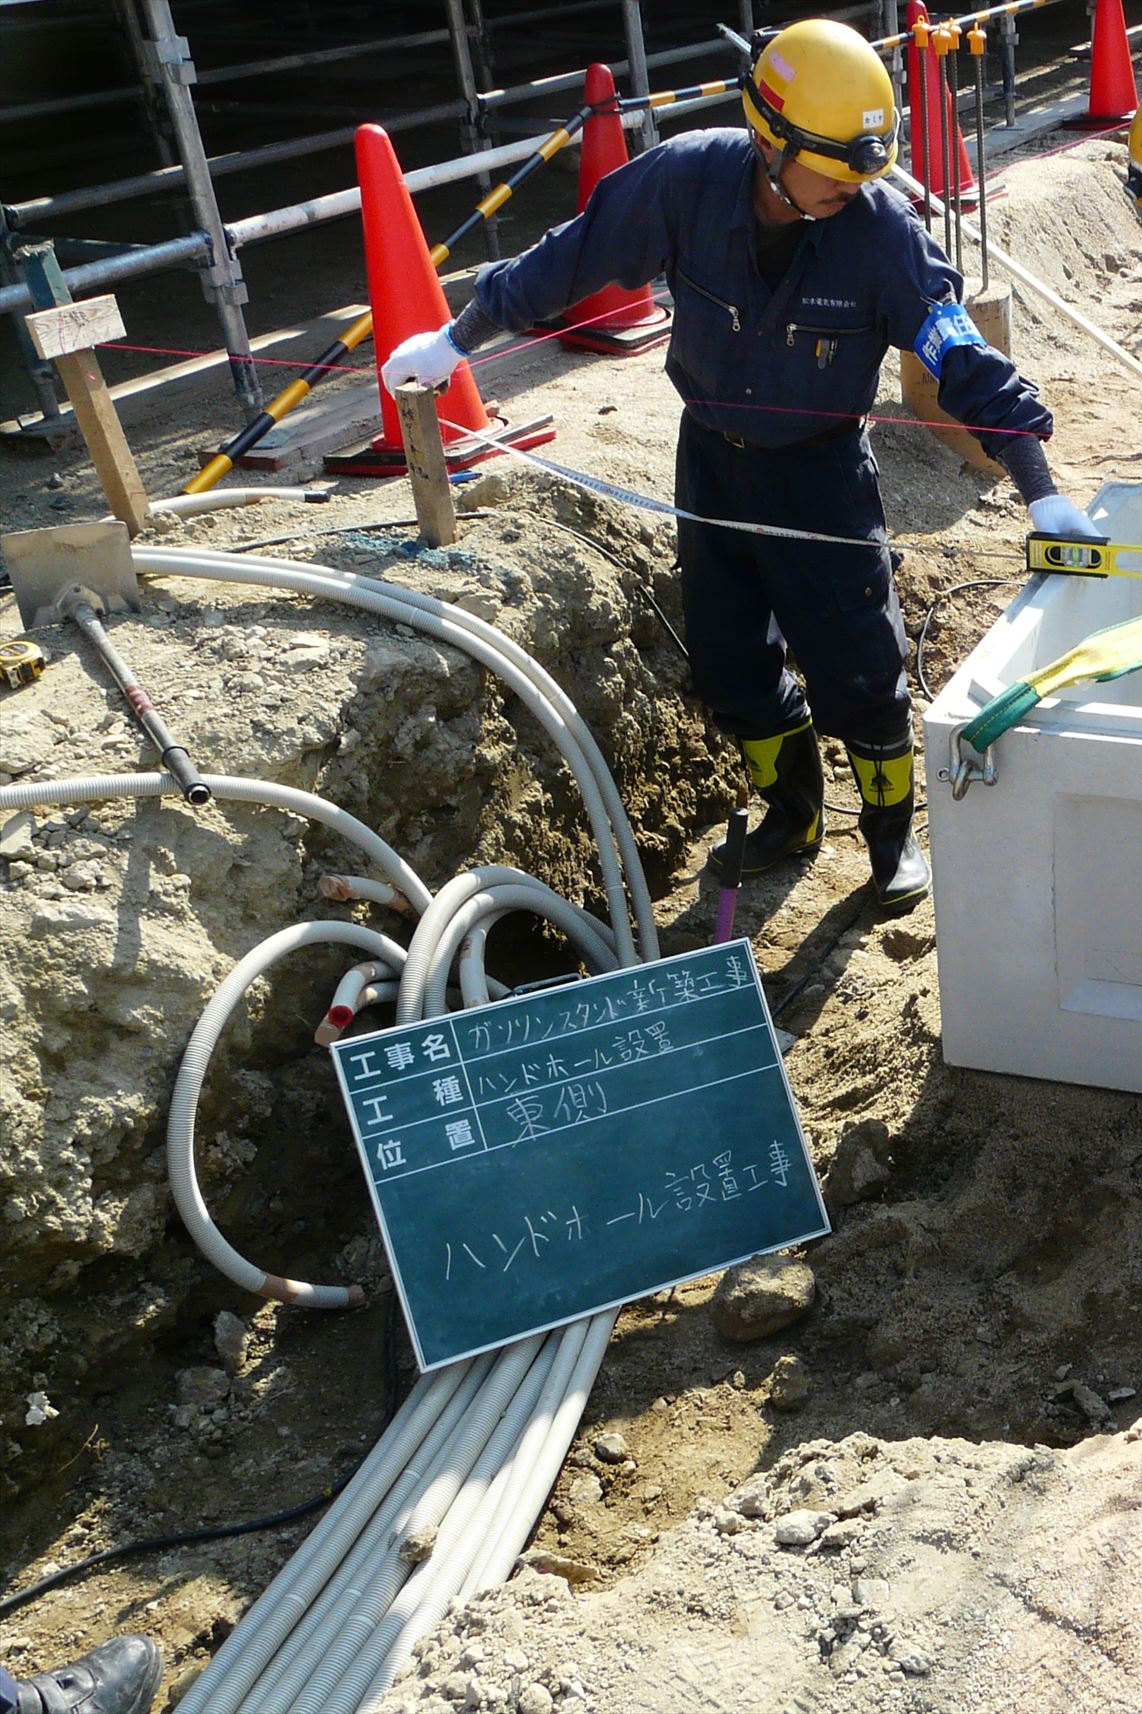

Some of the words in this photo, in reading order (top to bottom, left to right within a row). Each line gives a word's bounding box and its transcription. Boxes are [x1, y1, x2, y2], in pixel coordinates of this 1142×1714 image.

[350, 1033, 451, 1081] 工事名
[478, 1020, 675, 1096] ハンドホール設置
[506, 1080, 608, 1148] 東側
[446, 1140, 792, 1281] ハンドホール設置工事
